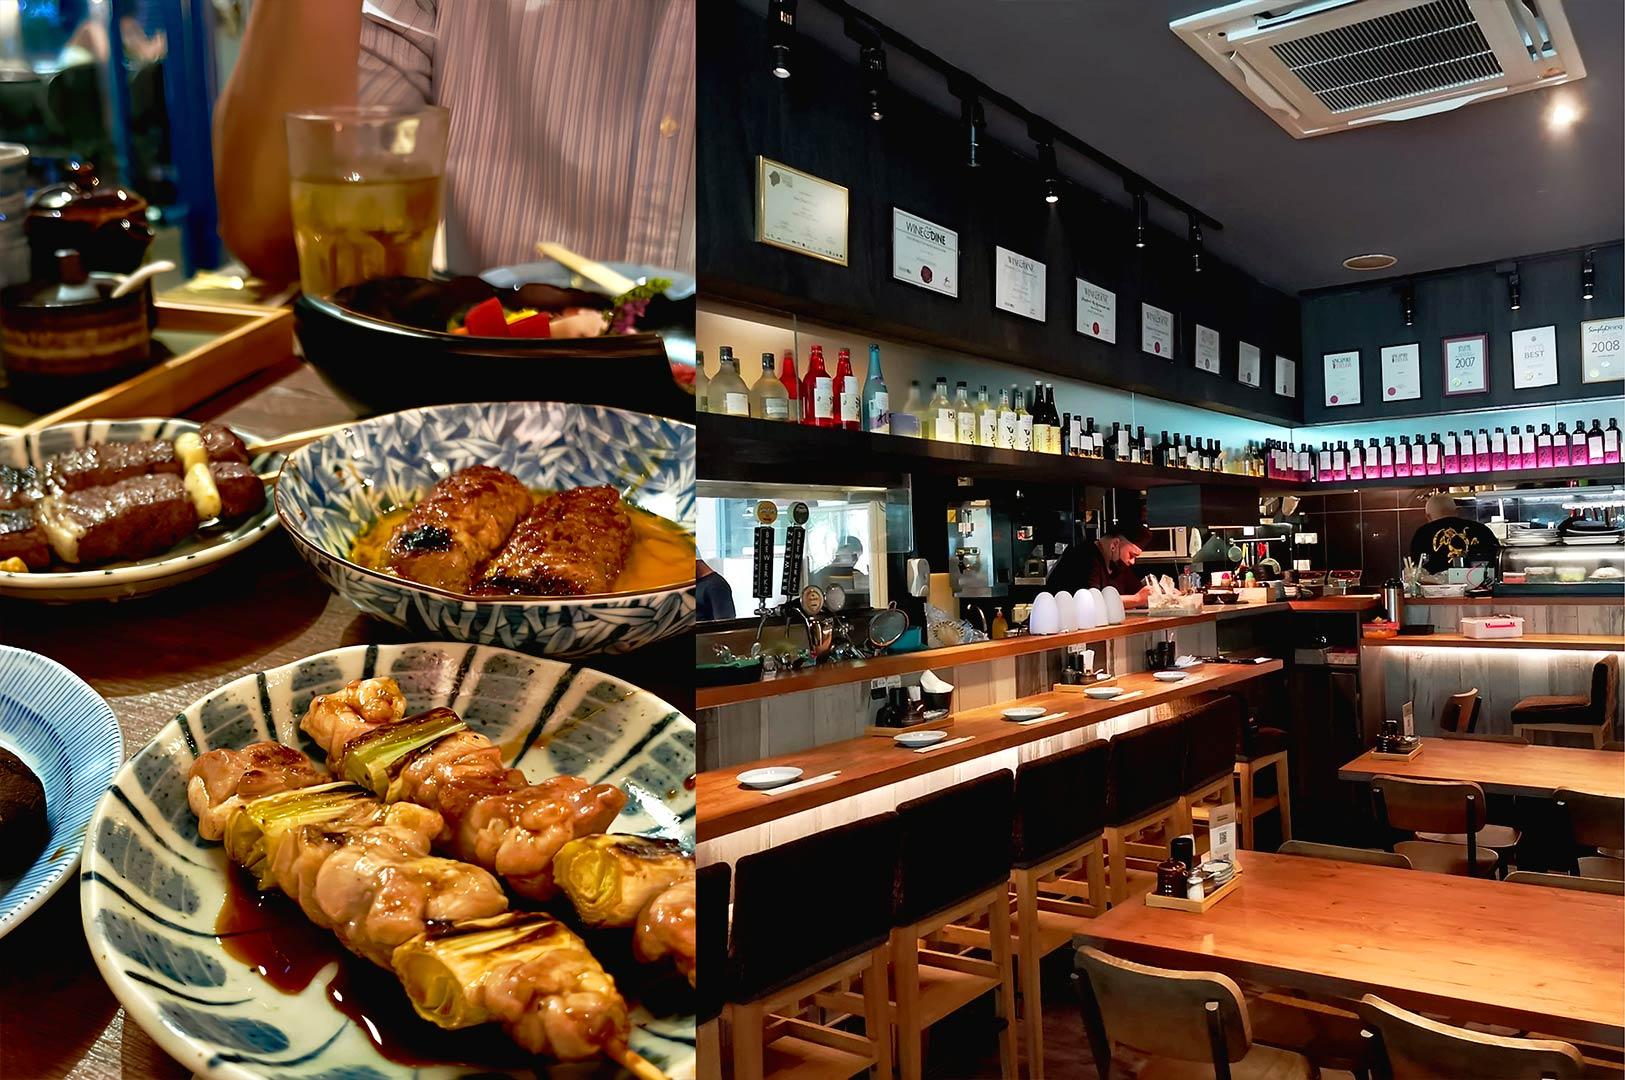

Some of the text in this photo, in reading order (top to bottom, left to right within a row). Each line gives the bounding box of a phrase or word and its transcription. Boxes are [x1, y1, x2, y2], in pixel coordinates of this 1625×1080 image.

[1591, 339, 1620, 353] 2008
[1455, 356, 1475, 369] 2007
[763, 531, 771, 593] BREWERKZ
